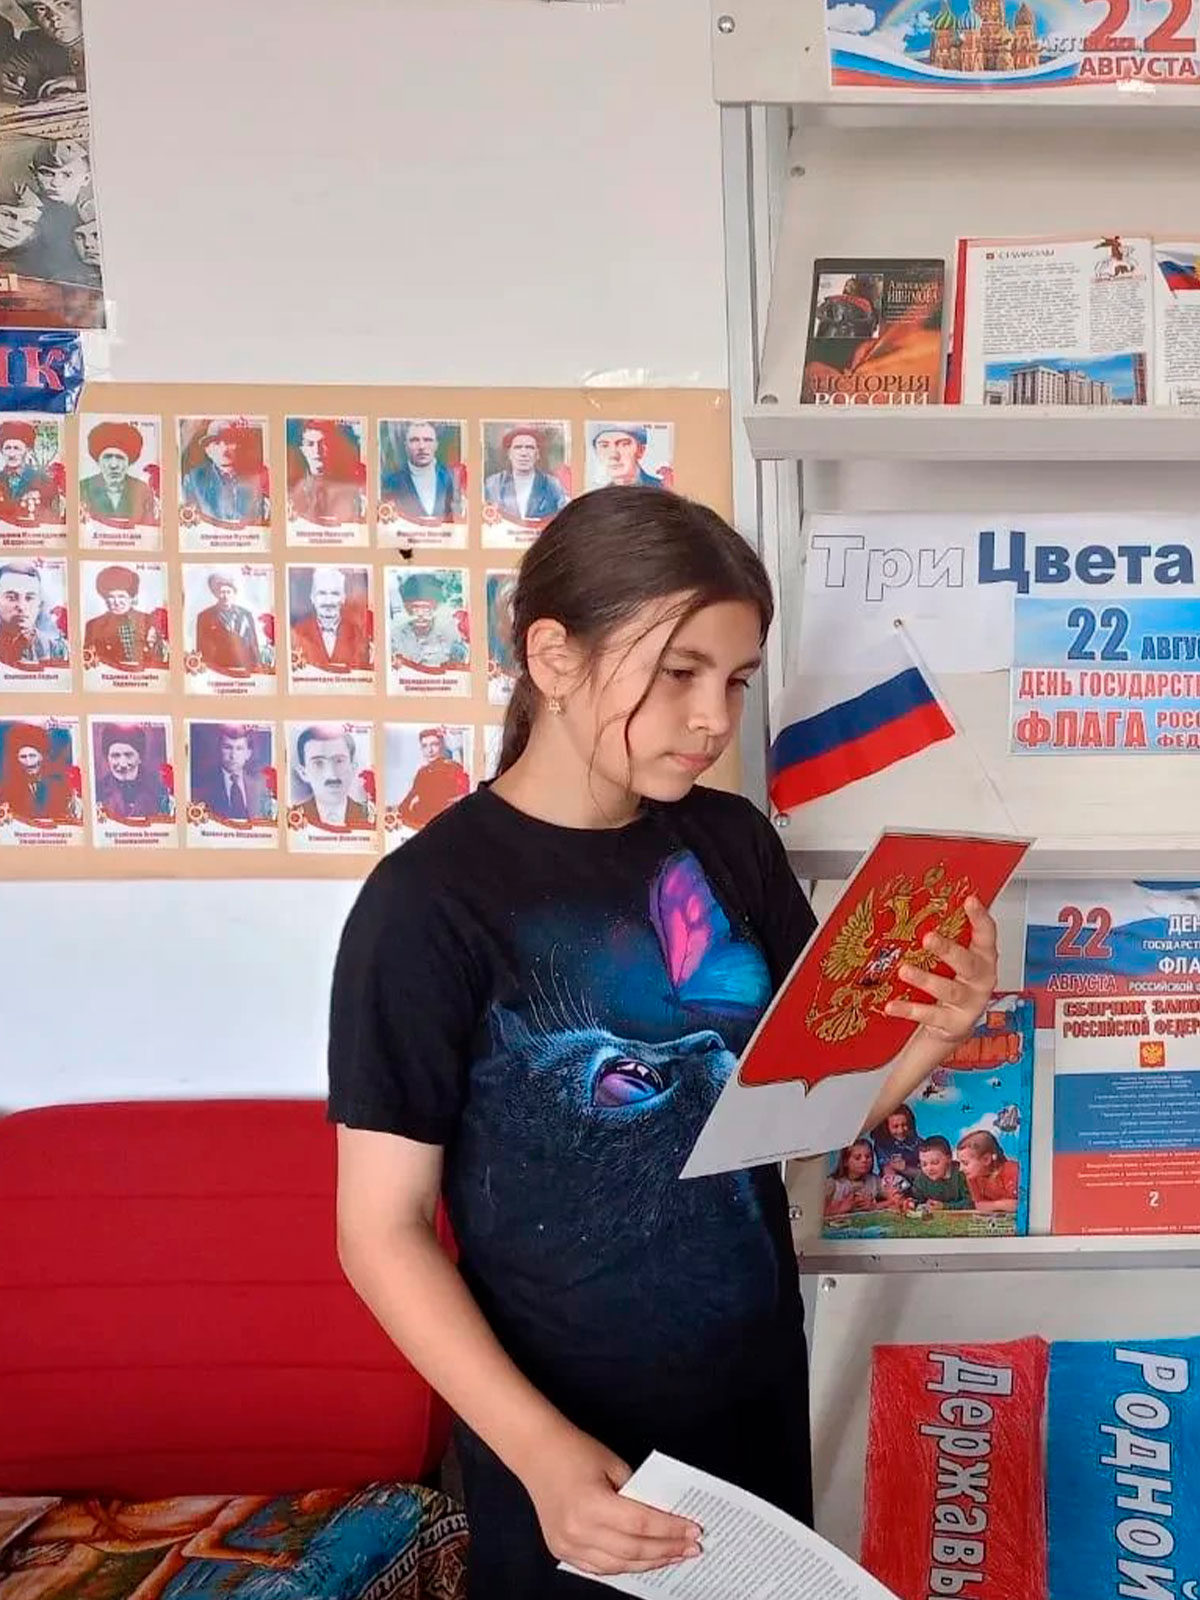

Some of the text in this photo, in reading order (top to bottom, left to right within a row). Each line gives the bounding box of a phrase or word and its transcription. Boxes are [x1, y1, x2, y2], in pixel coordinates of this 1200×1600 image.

[1079, 57, 1196, 77] АВГУСТА
[815, 375, 930, 392] ИСТОРИЯ
[814, 392, 930, 405] РОССИИ
[812, 534, 965, 602] Три
[978, 531, 1195, 594] Цвета
[1067, 607, 1129, 661] 22
[1019, 671, 1073, 699] ДЕНЬ
[1016, 710, 1147, 748] ФЛАГА
[1055, 905, 1113, 959] 22
[1048, 974, 1117, 993] АВГУСТА
[1128, 979, 1193, 992] РОССИЙСКОЙ
[1063, 1001, 1147, 1017] СБОРНИК
[1063, 1016, 1150, 1038] РОССИЙСКОЙ
[1149, 1191, 1159, 1207] 2
[1100, 1348, 1200, 1600] Родной
